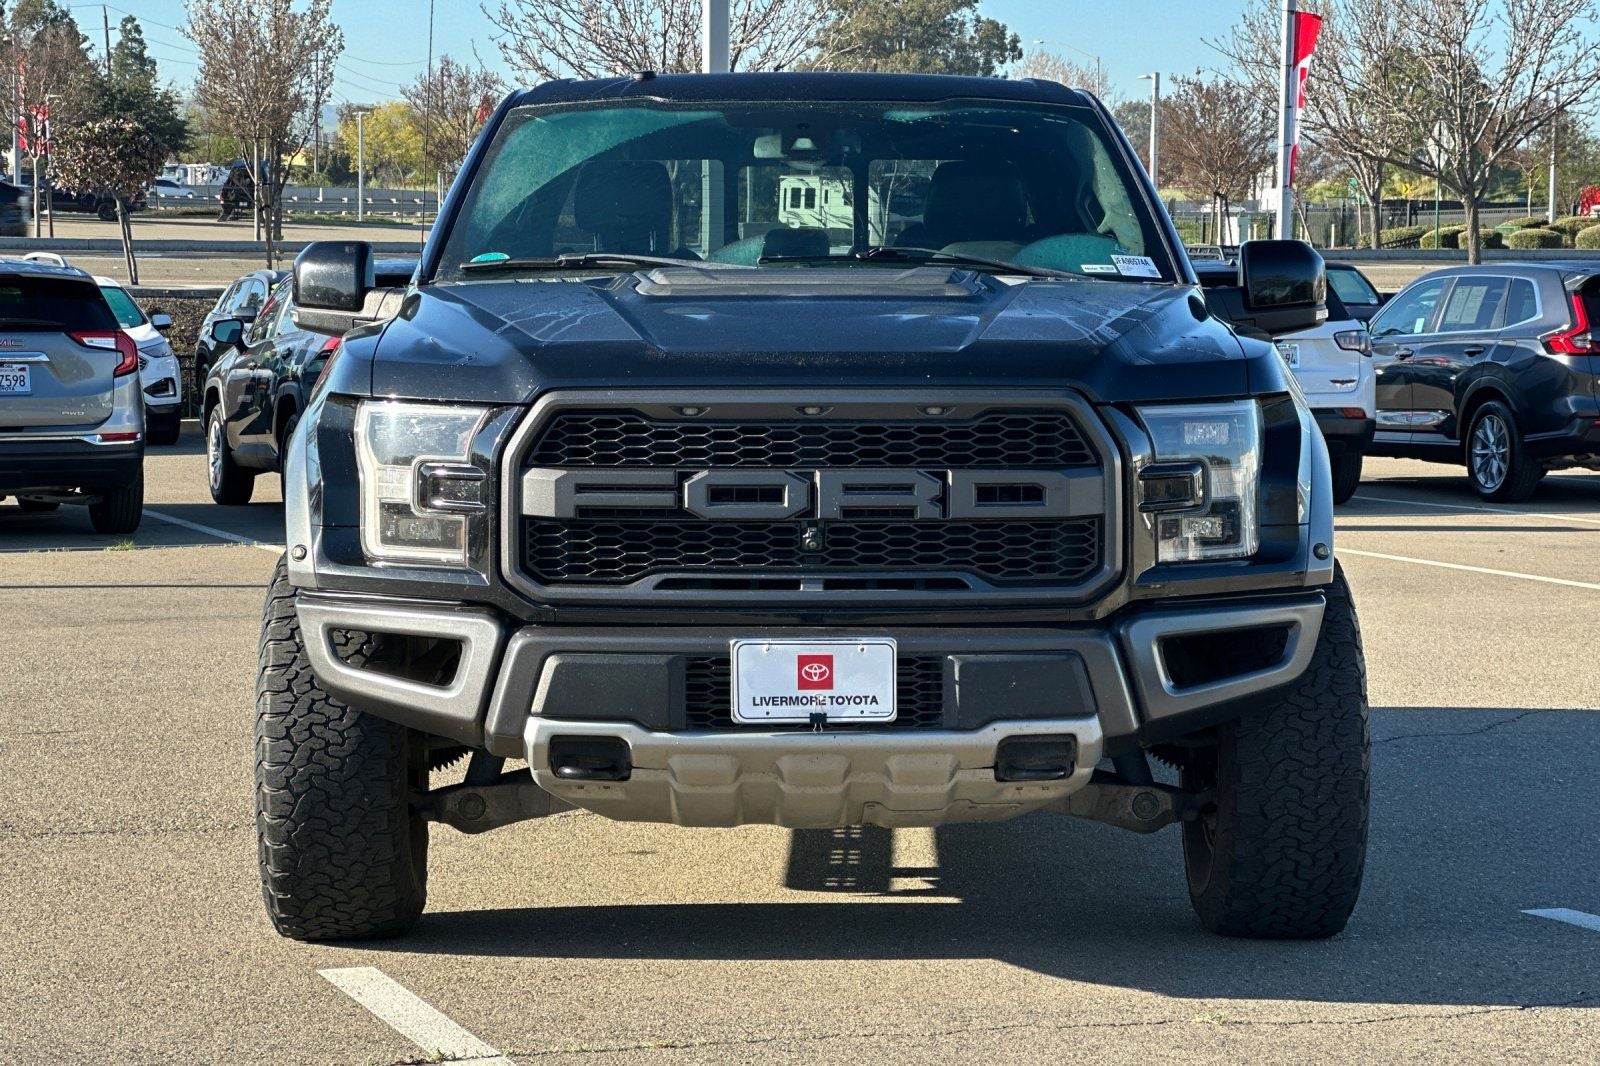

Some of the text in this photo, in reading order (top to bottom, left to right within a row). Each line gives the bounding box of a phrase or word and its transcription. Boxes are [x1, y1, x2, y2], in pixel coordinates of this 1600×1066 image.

[522, 468, 1104, 518] FORD
[752, 695, 879, 706] LIVERMORE TOYOTA
